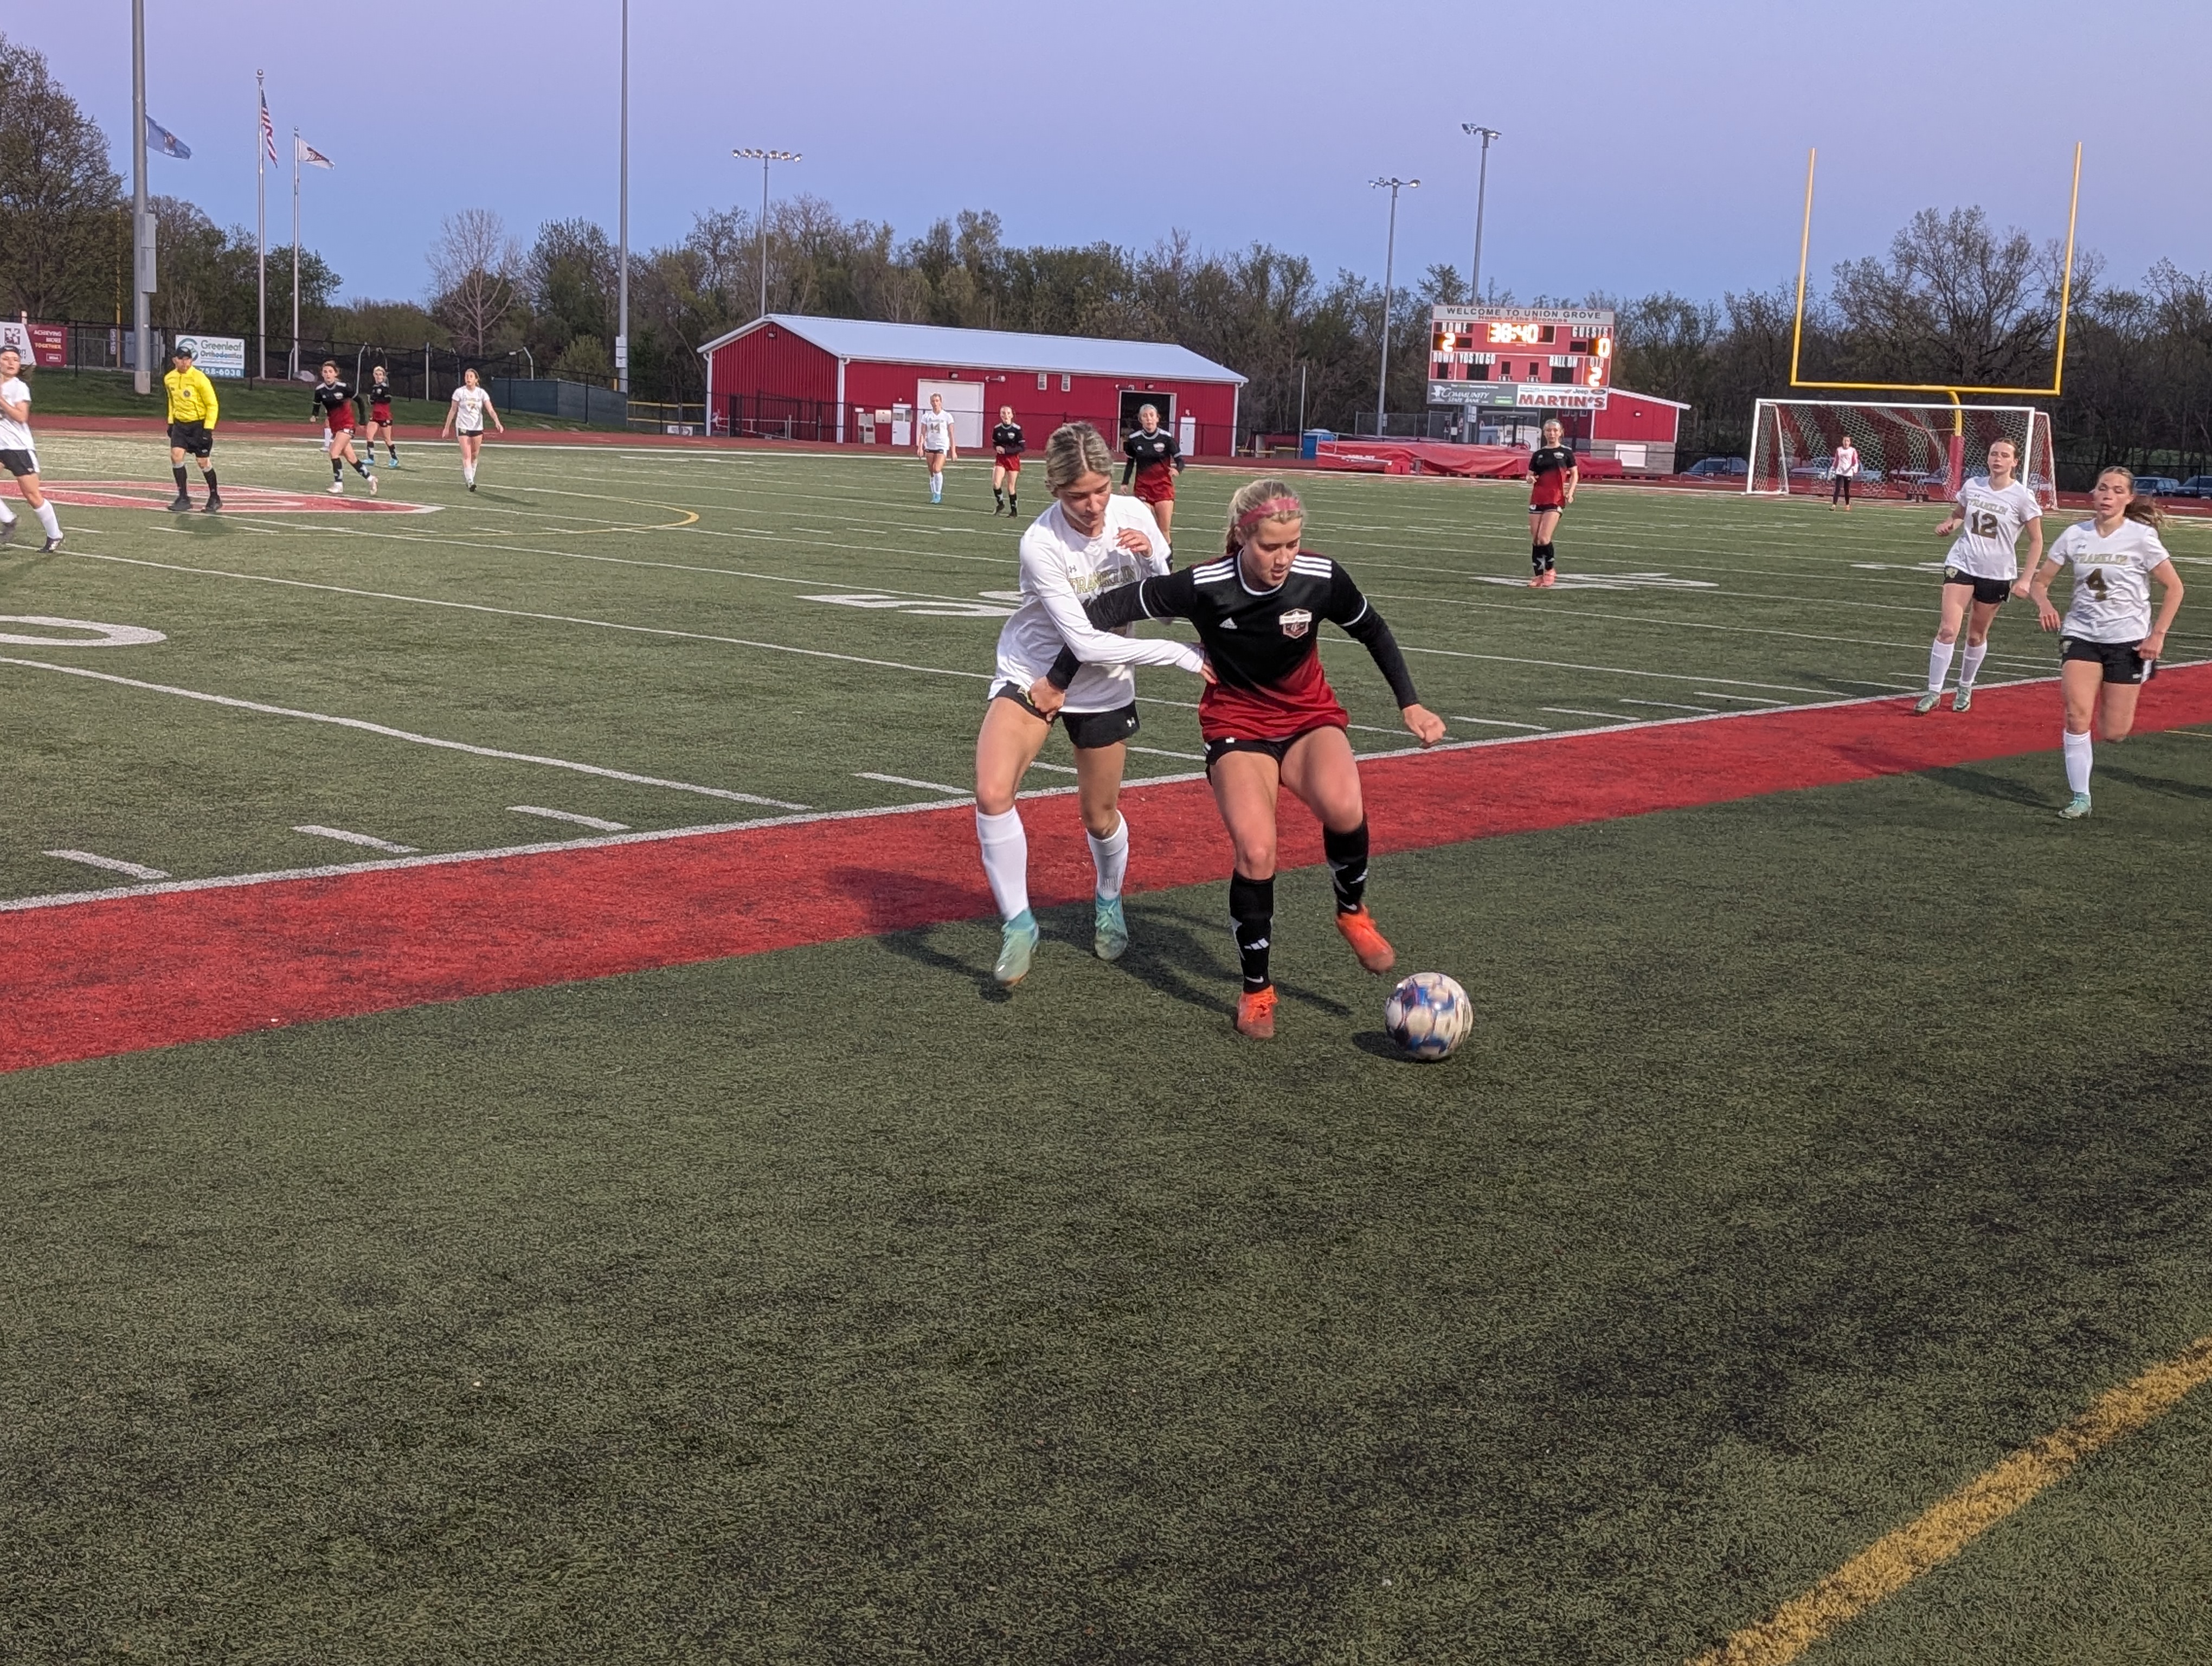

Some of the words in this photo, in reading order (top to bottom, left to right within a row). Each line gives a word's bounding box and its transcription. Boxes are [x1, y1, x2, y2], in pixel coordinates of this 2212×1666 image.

[1447, 307, 1501, 316] WELCOME
[1442, 322, 1467, 334] HOME
[1572, 326, 1608, 338] GUESTS
[201, 339, 242, 351] Greenleaf
[1442, 332, 1456, 352] 2
[1598, 338, 1610, 357] 0
[200, 350, 242, 359] Orthodontics
[1433, 353, 1454, 363] DOWN
[1549, 356, 1565, 367] BALL
[1567, 356, 1578, 368] ON
[1589, 367, 1603, 387] 2
[930, 423, 940, 433] 14
[1971, 510, 1998, 539] 12
[2086, 568, 2107, 602] 4
